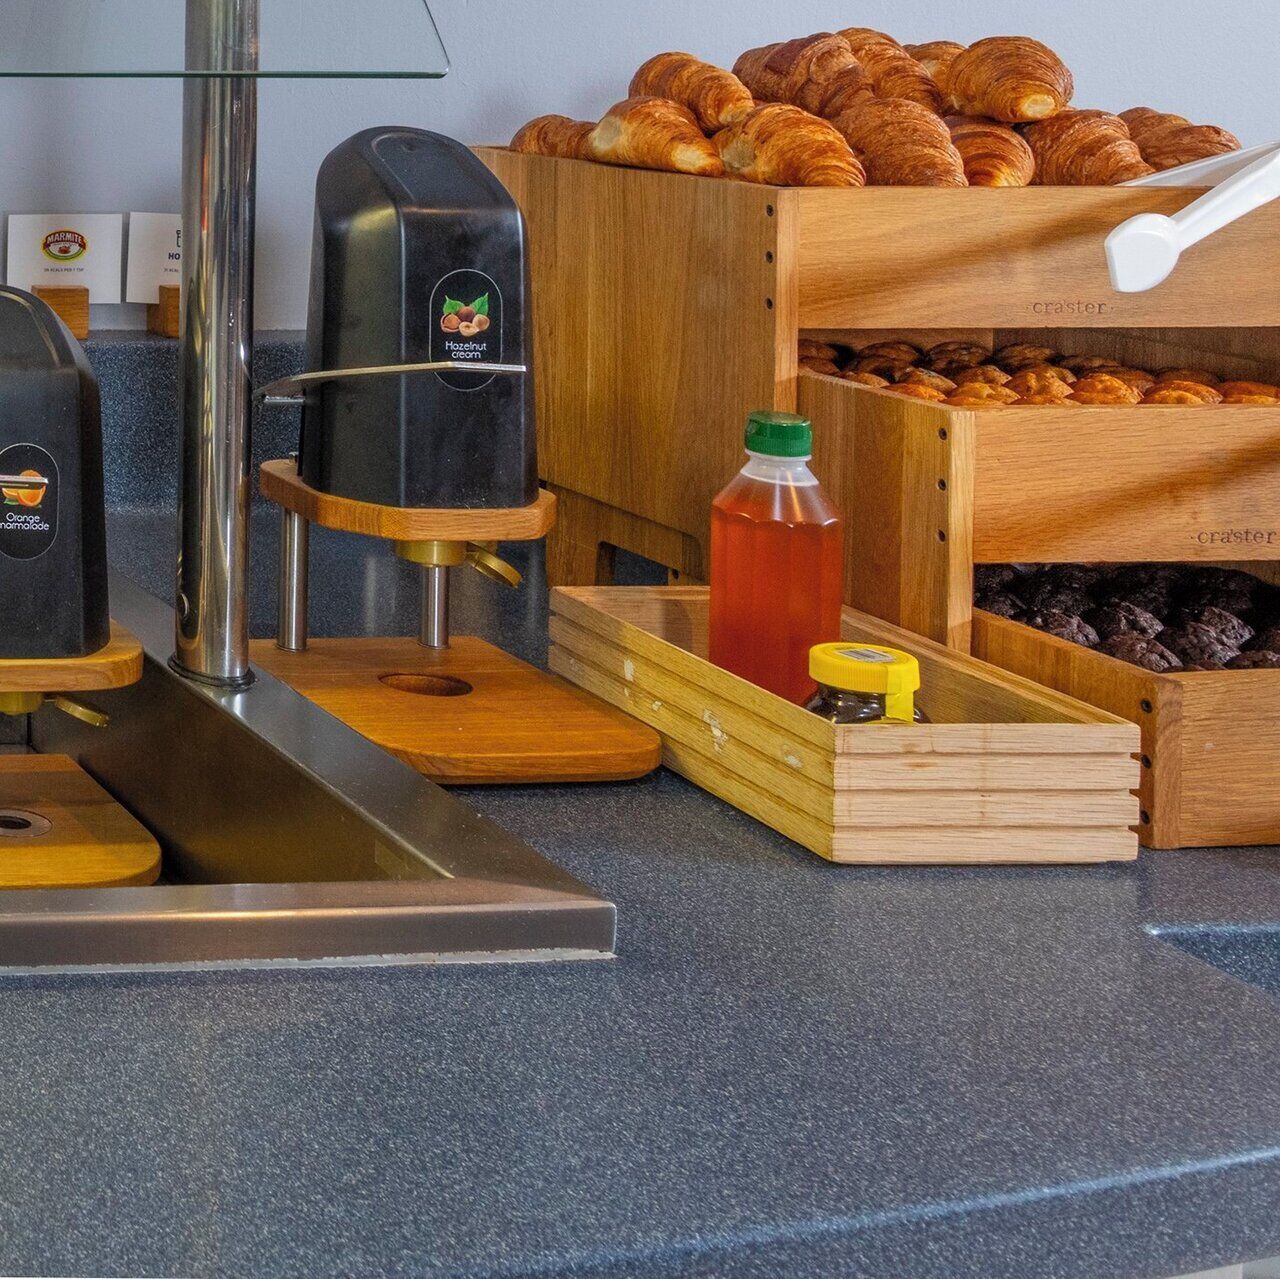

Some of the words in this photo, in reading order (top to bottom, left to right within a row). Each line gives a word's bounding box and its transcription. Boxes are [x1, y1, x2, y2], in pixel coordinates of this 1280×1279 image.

[48, 232, 83, 243] MARMITE
[445, 340, 488, 351] Hazelnut
[451, 351, 482, 359] cream
[5, 512, 41, 524] Orange
